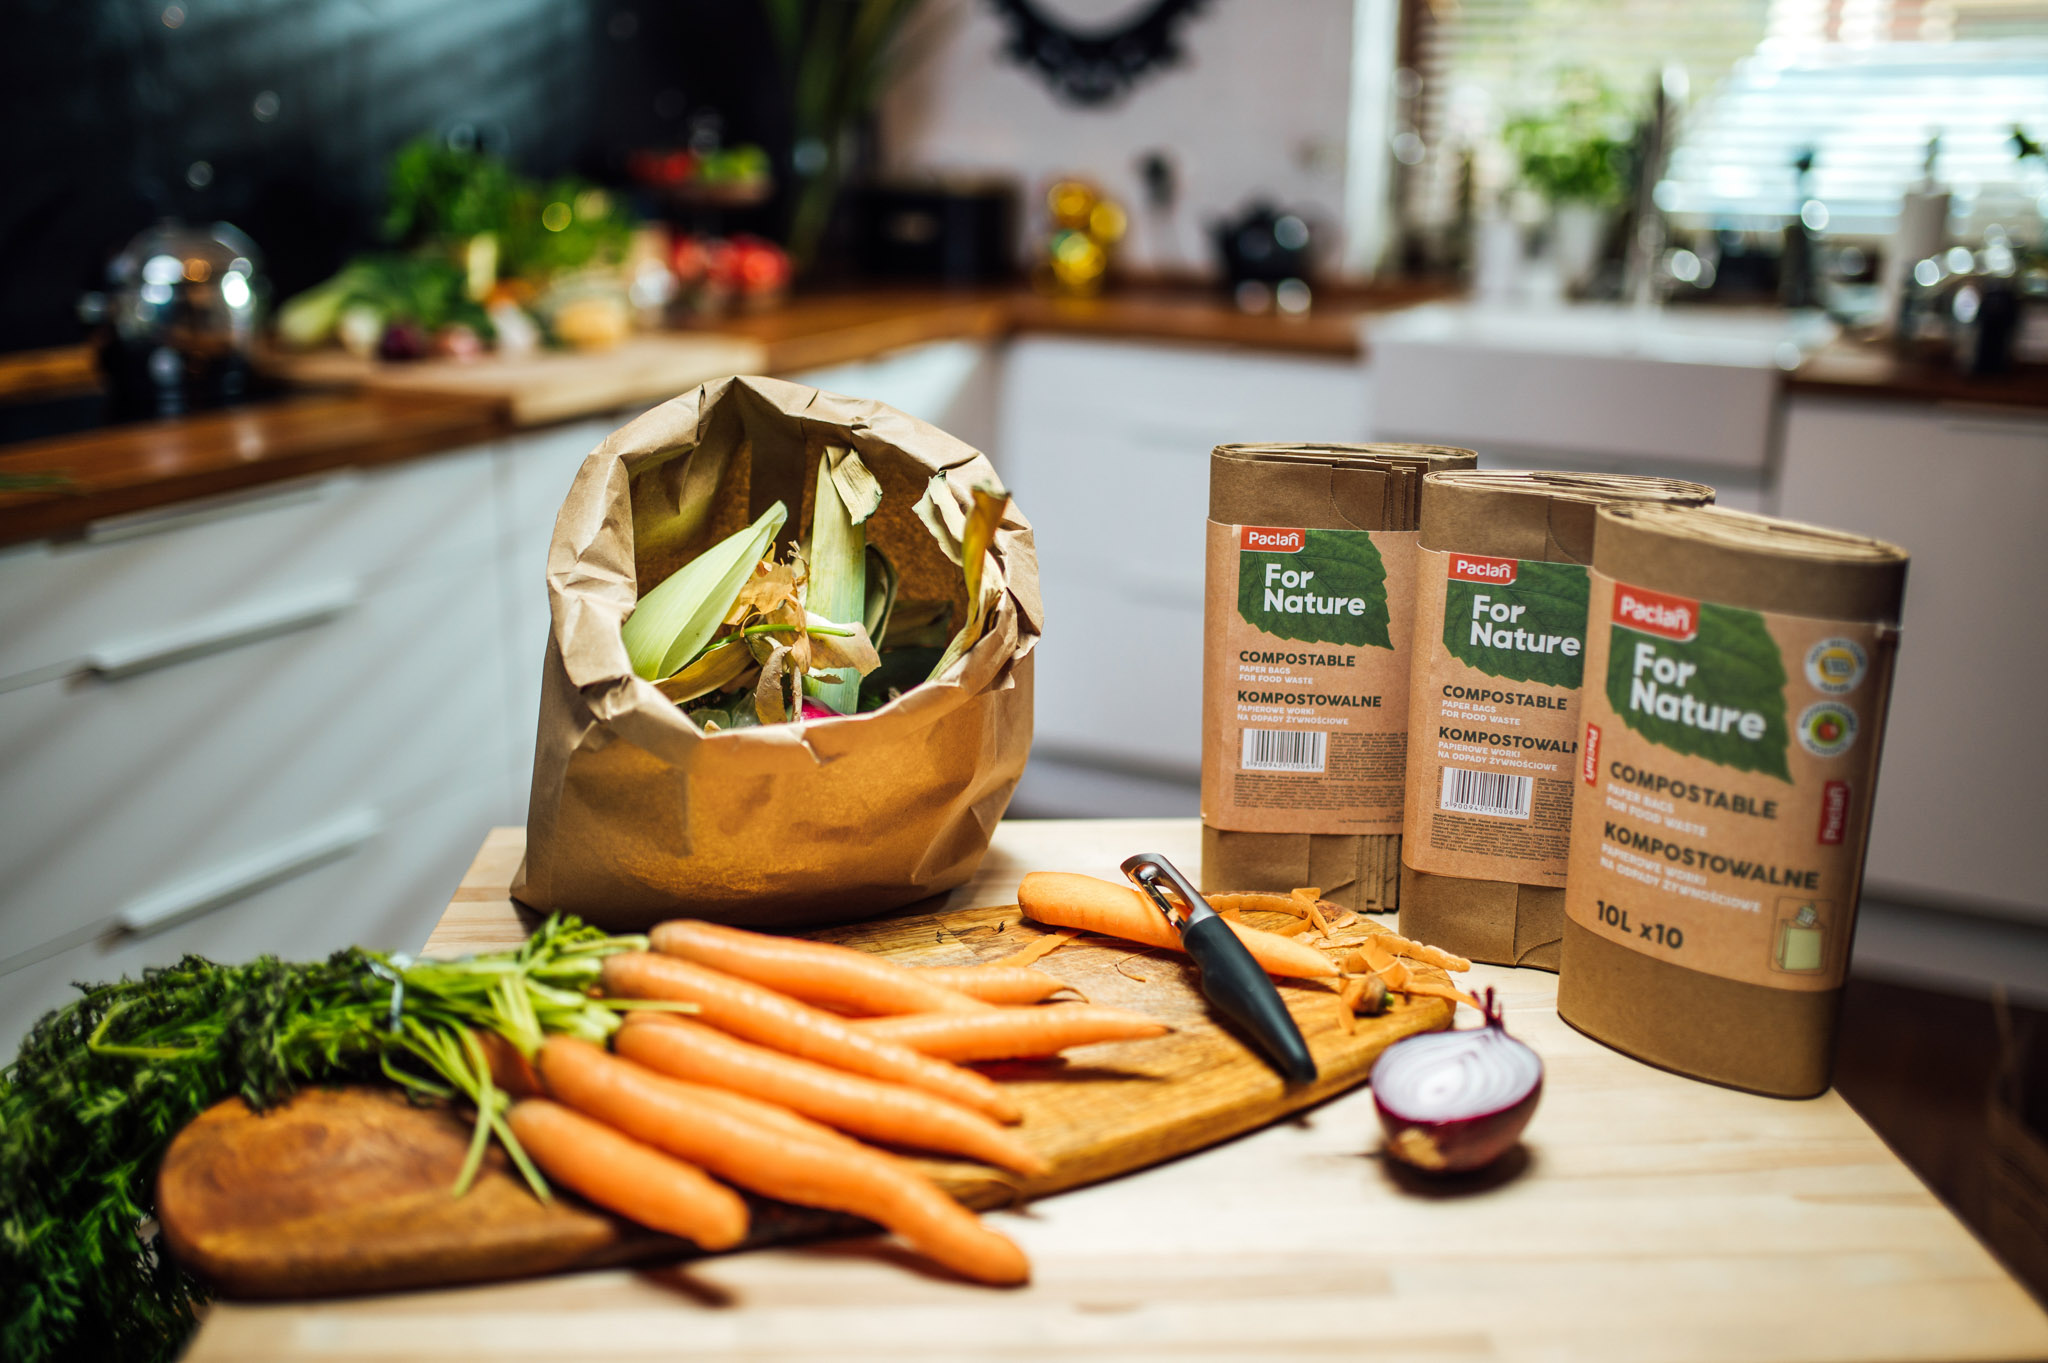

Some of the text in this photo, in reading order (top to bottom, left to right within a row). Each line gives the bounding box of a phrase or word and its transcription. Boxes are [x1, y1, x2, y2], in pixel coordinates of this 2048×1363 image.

[1265, 563, 1314, 588] For
[1264, 588, 1366, 616] Nature
[1472, 594, 1526, 623] For
[1470, 620, 1581, 656] Nature
[1239, 665, 1290, 675] PAPER BAGS
[1240, 650, 1356, 667] COMPOSTABLE
[1634, 642, 1696, 688] For
[1239, 674, 1313, 685] FOR FOOD WASTE
[1237, 704, 1314, 715] PAPIEROWE WORKI
[1238, 690, 1382, 708] KOMPOSTOWALNE
[1442, 684, 1568, 711] COMPOSTABLE
[1442, 700, 1496, 714] PAPER BAGS
[1630, 676, 1766, 740] Nature
[1251, 715, 1284, 724] ODPADY
[1286, 715, 1348, 726] ŻYWNOŚCIOWE
[1442, 709, 1520, 726] FOR FOOD WASTE
[1438, 742, 1520, 758] PAPIEROWE WORKI
[1439, 726, 1578, 754] KOMPOSTOWALN
[1438, 751, 1558, 772] NA ODPADY ŻYWNOŚCIOWE
[1607, 783, 1674, 814] PAPER BAGS
[1610, 761, 1778, 820] COMPOSTABLE
[1453, 803, 1484, 812] 900942
[1488, 806, 1520, 816] 150069
[1606, 798, 1708, 838] FOR FOOD WASTE
[1601, 842, 1662, 874] PAPIEROWE
[1664, 862, 1708, 887] WORKI
[1604, 821, 1820, 890] KOMPOSTOWALNE
[1600, 856, 1615, 871] NA
[1617, 863, 1660, 887] ODPADY
[1597, 900, 1684, 950] 10L x10
